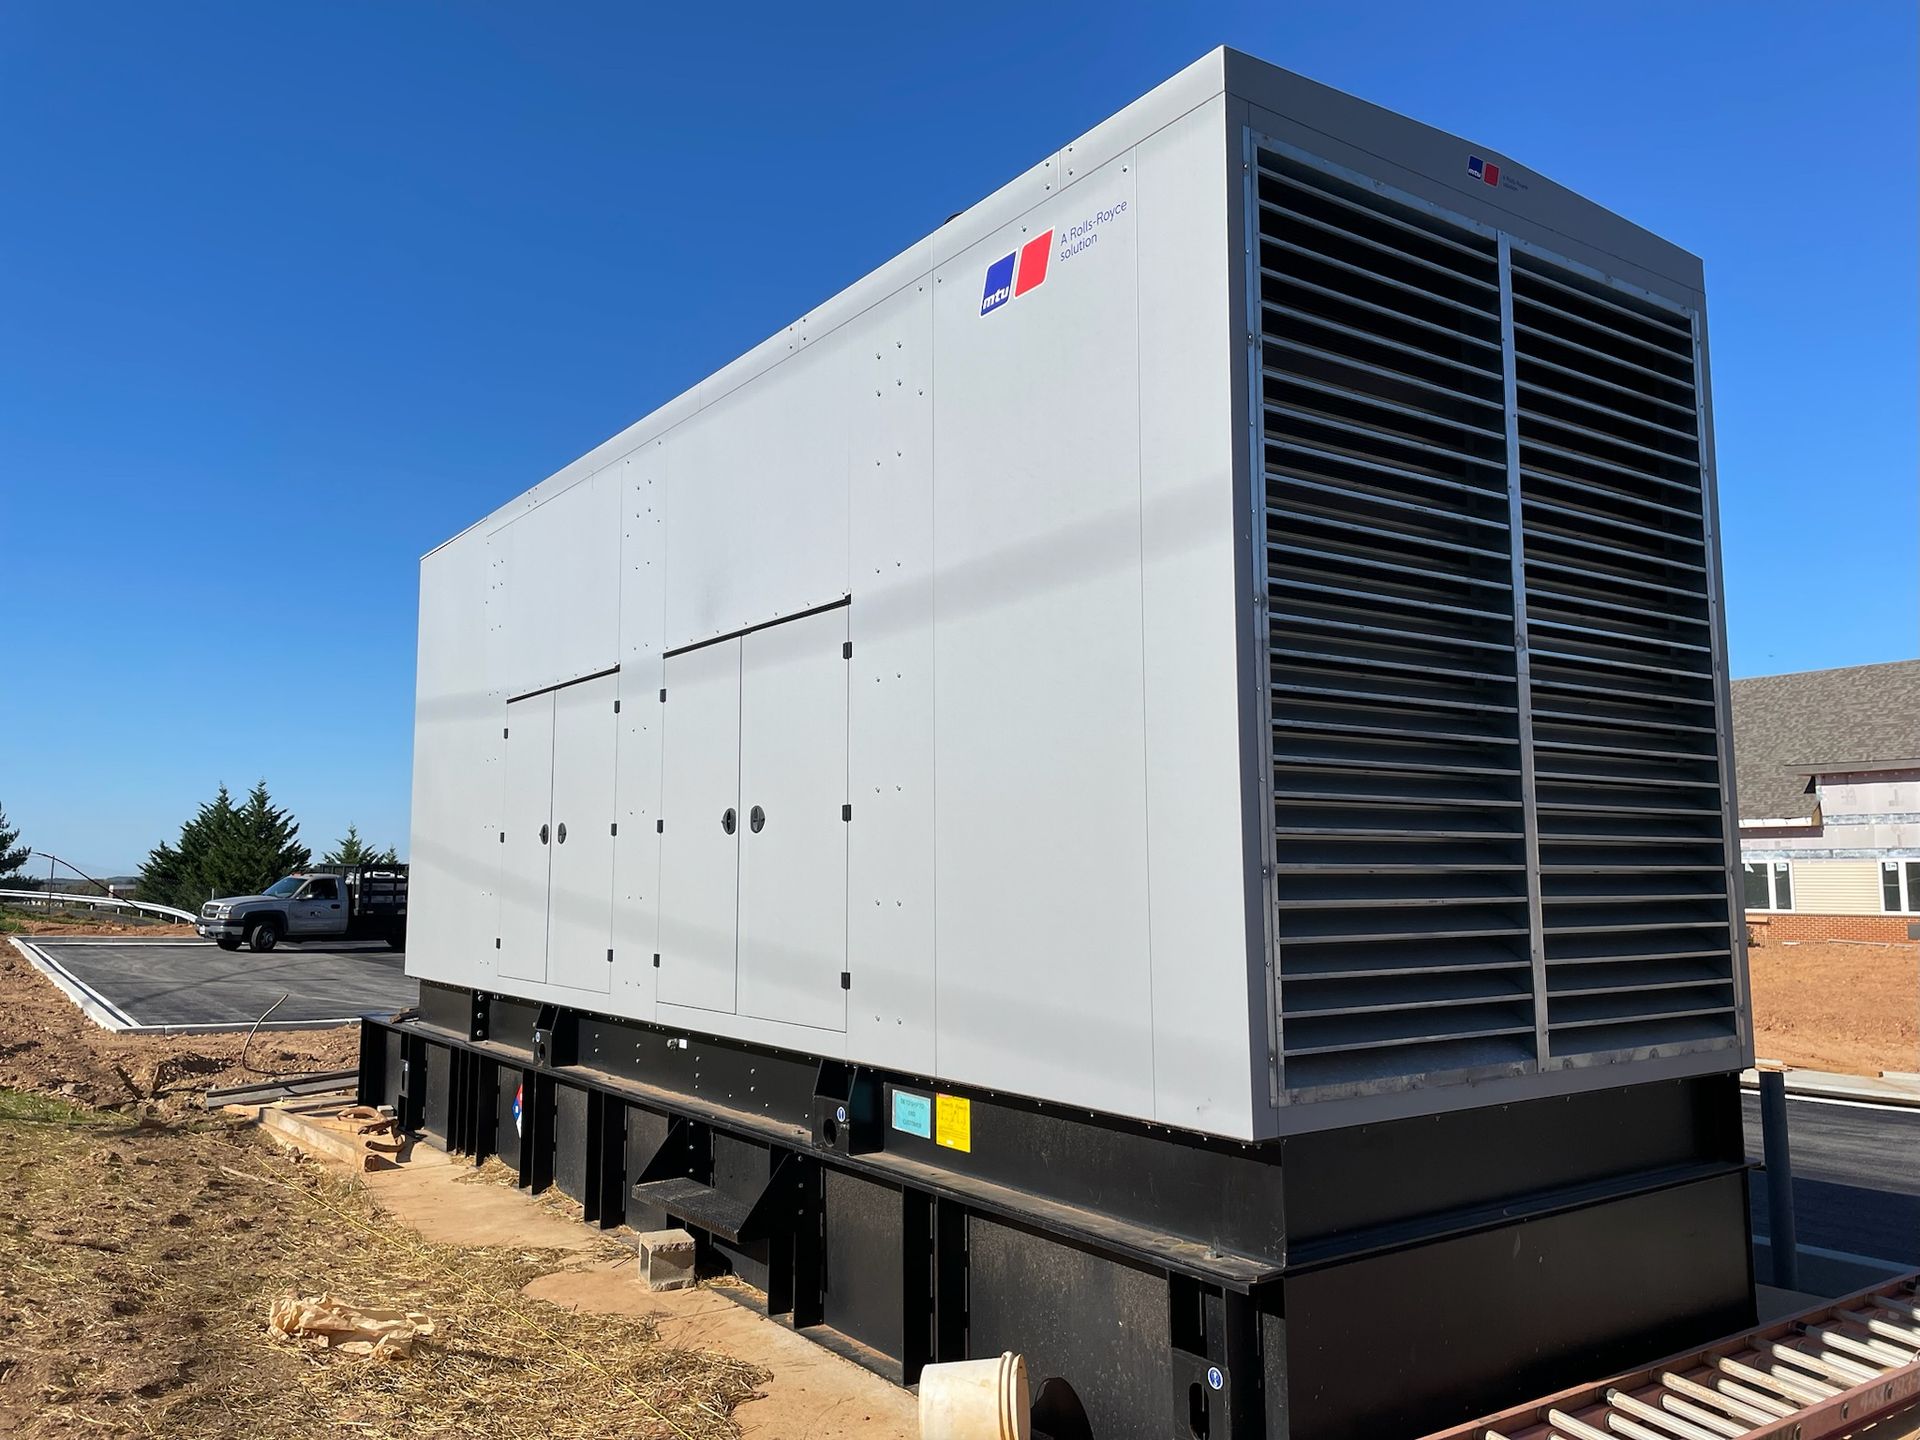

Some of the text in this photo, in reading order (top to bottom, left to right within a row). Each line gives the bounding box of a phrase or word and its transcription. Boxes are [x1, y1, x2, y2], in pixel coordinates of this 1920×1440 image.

[1060, 200, 1128, 246] A Rolls-Royce
[1060, 233, 1098, 262] solution
[982, 286, 1010, 310] mtu
